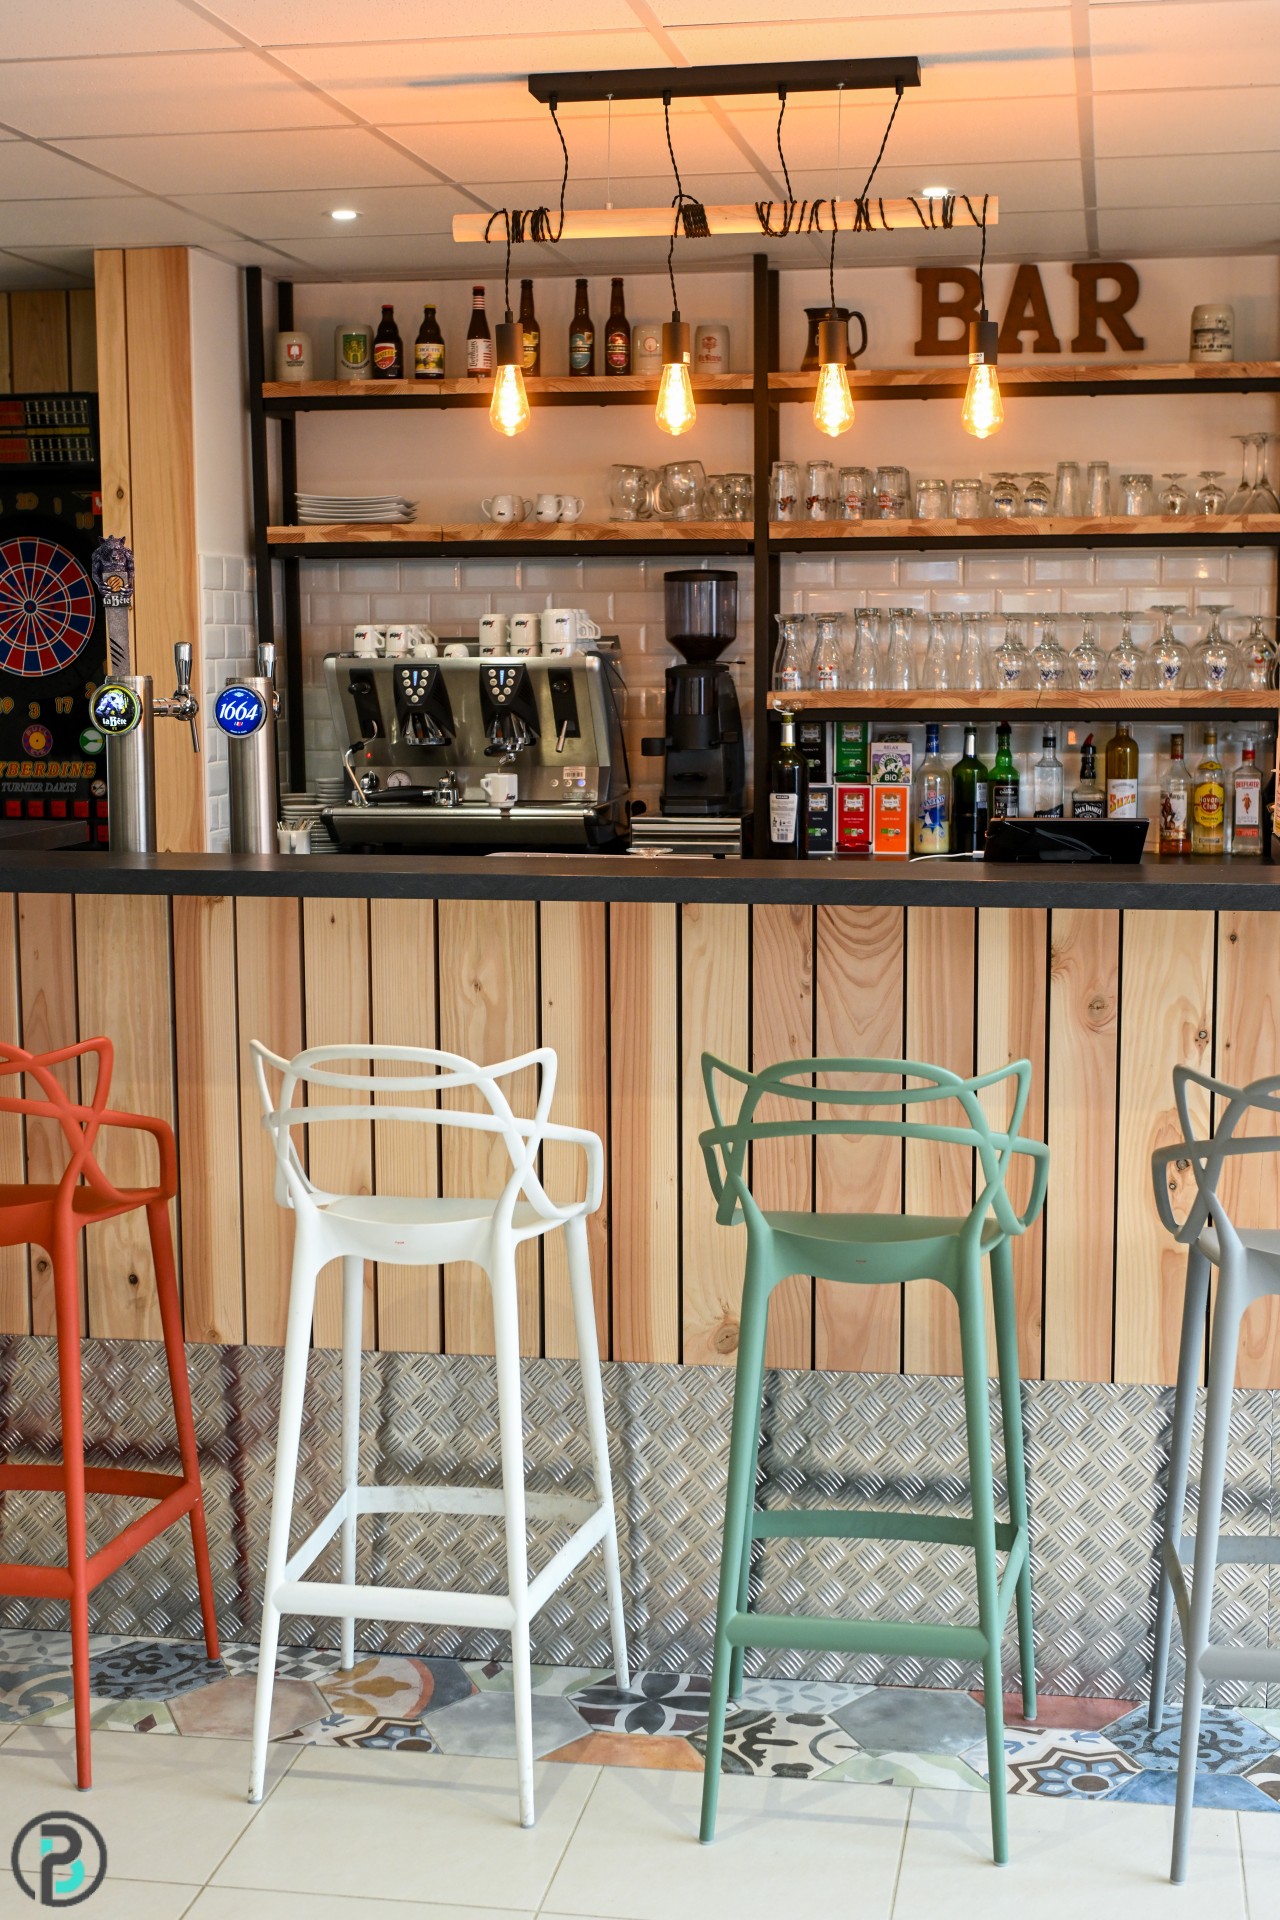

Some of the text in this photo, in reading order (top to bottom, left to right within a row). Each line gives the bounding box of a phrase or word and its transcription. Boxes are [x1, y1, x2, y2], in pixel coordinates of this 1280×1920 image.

[914, 262, 1145, 357] BAR
[28, 702, 41, 720] 3
[55, 696, 74, 714] 17
[219, 700, 259, 721] 1664
[1, 782, 77, 793] TURNIER DARTS
